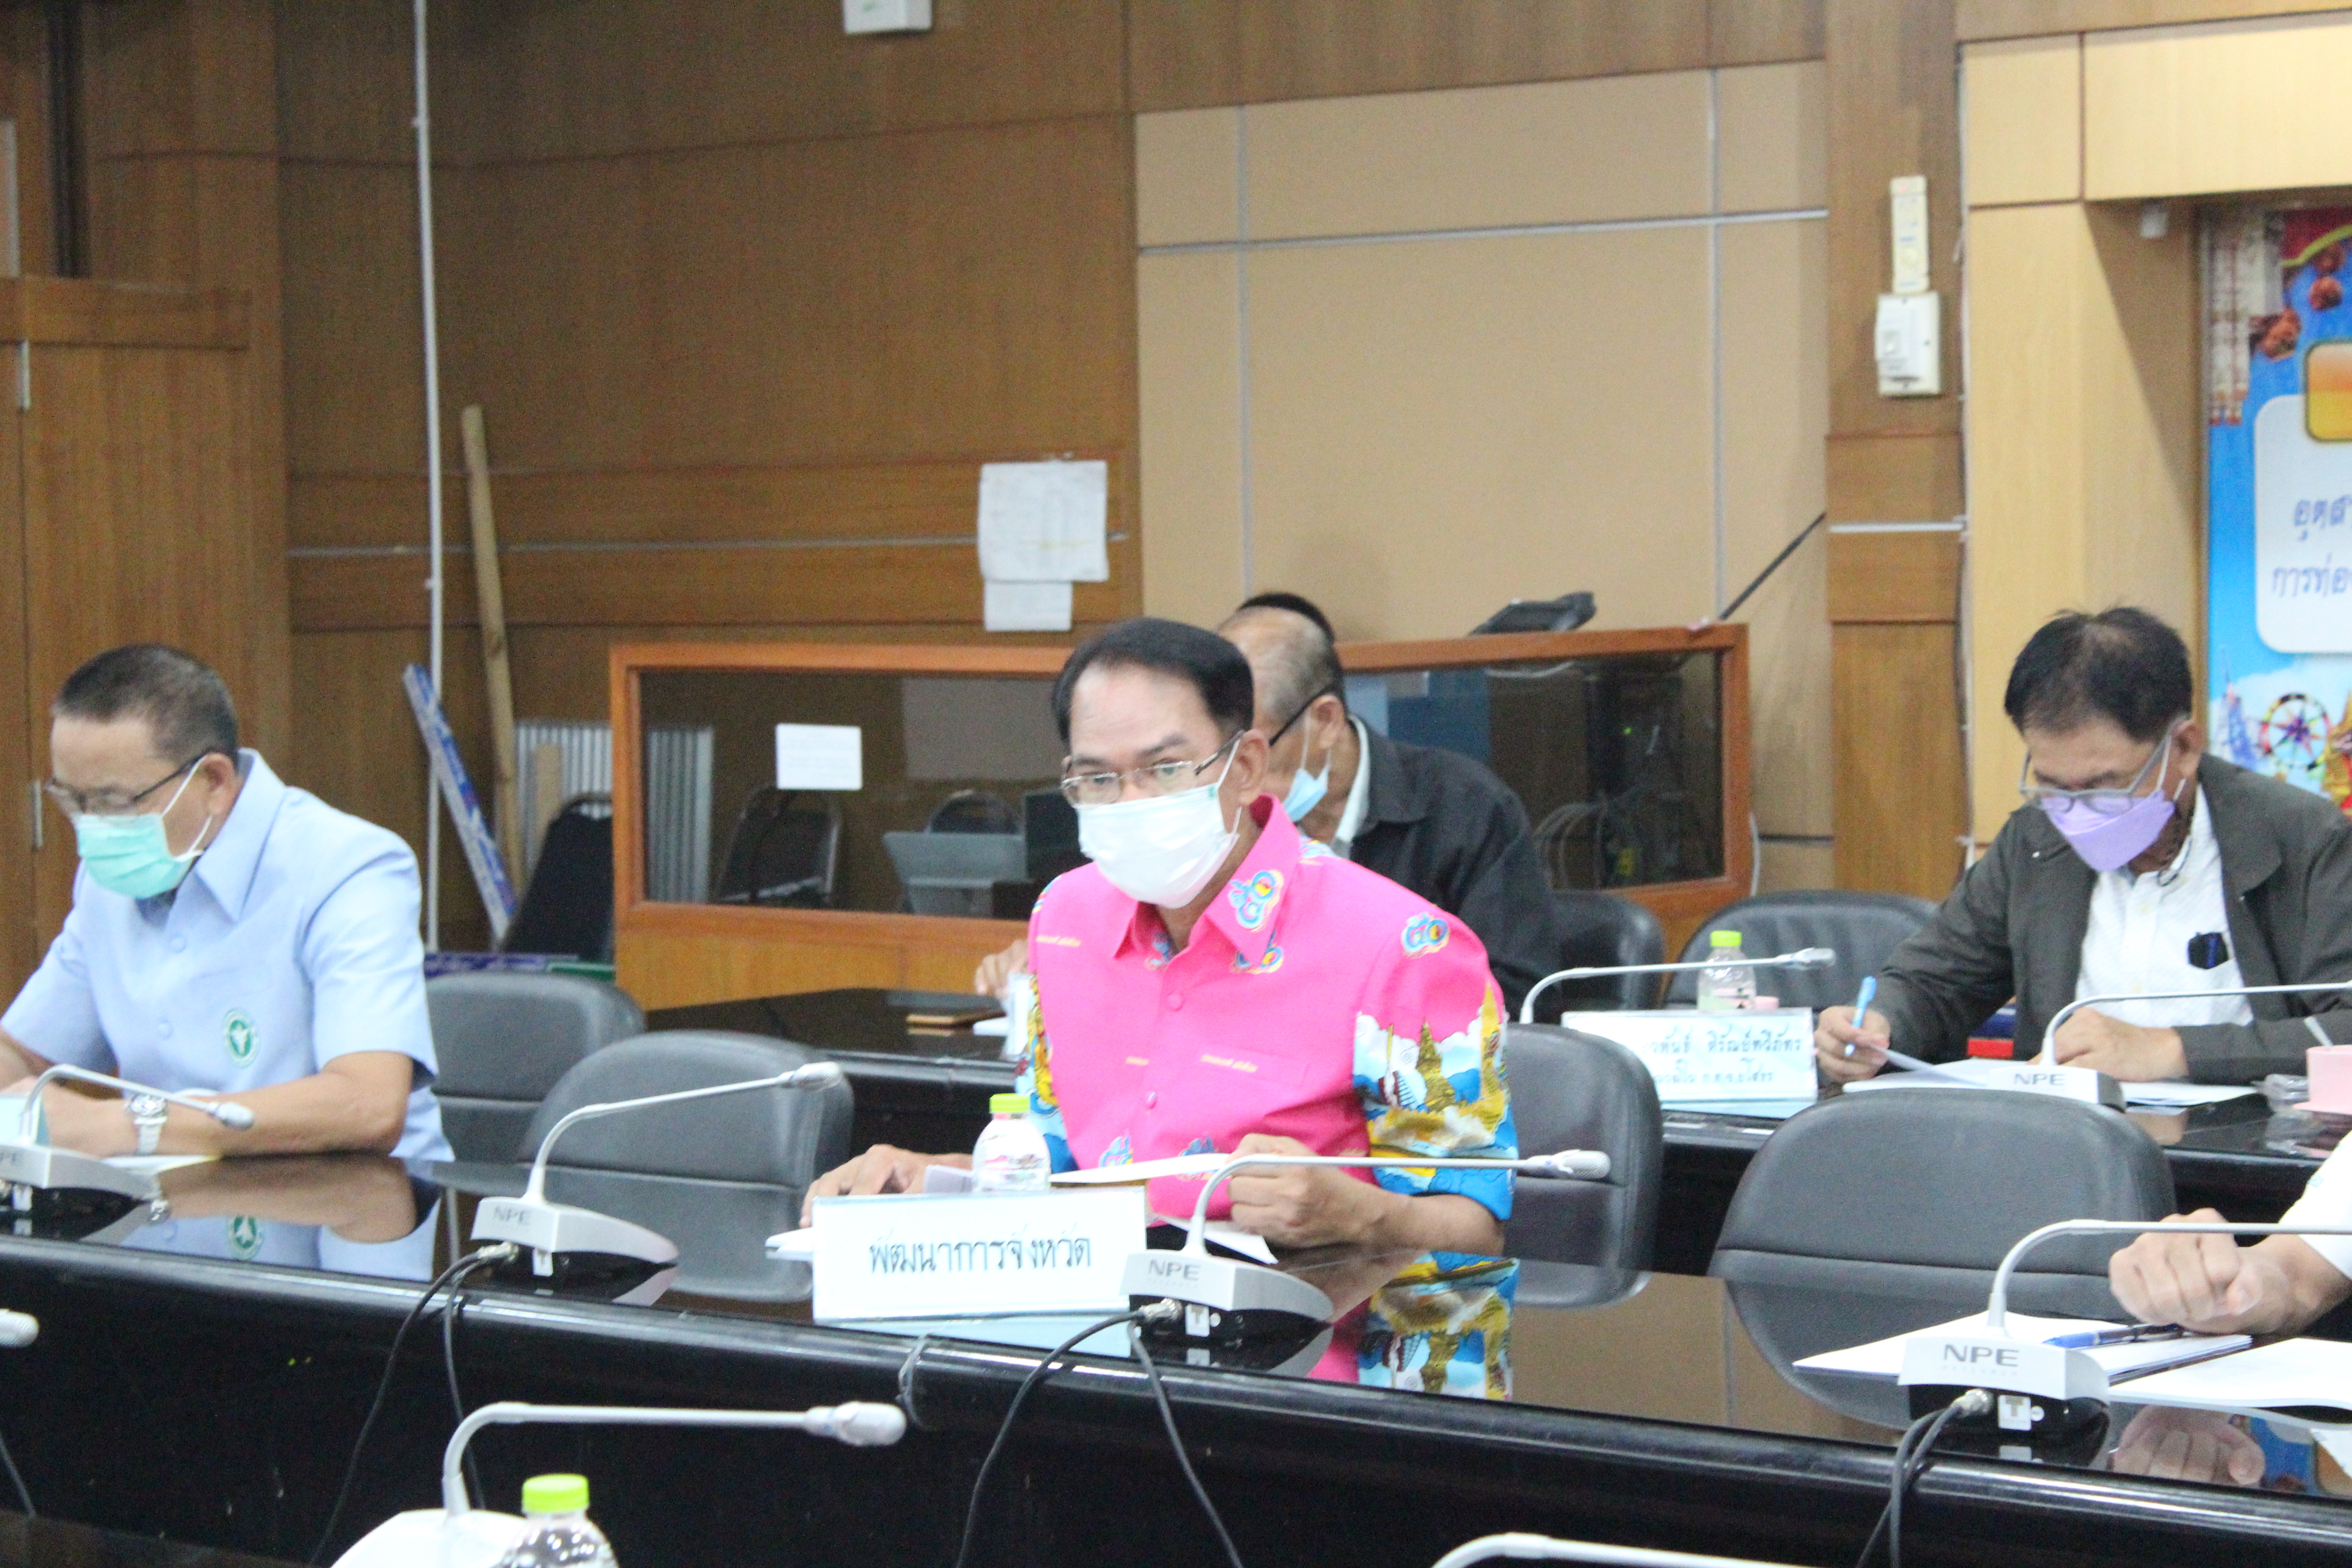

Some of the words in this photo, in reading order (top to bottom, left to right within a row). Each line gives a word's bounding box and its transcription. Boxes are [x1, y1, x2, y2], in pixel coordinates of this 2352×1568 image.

[2272, 552, 2352, 598] การท่อ
[2014, 1073, 2066, 1087] NPE
[868, 1222, 1092, 1275] พัฒนาการจังหวัด
[1148, 1259, 1201, 1282] NPE
[1944, 1343, 2019, 1367] NPE
